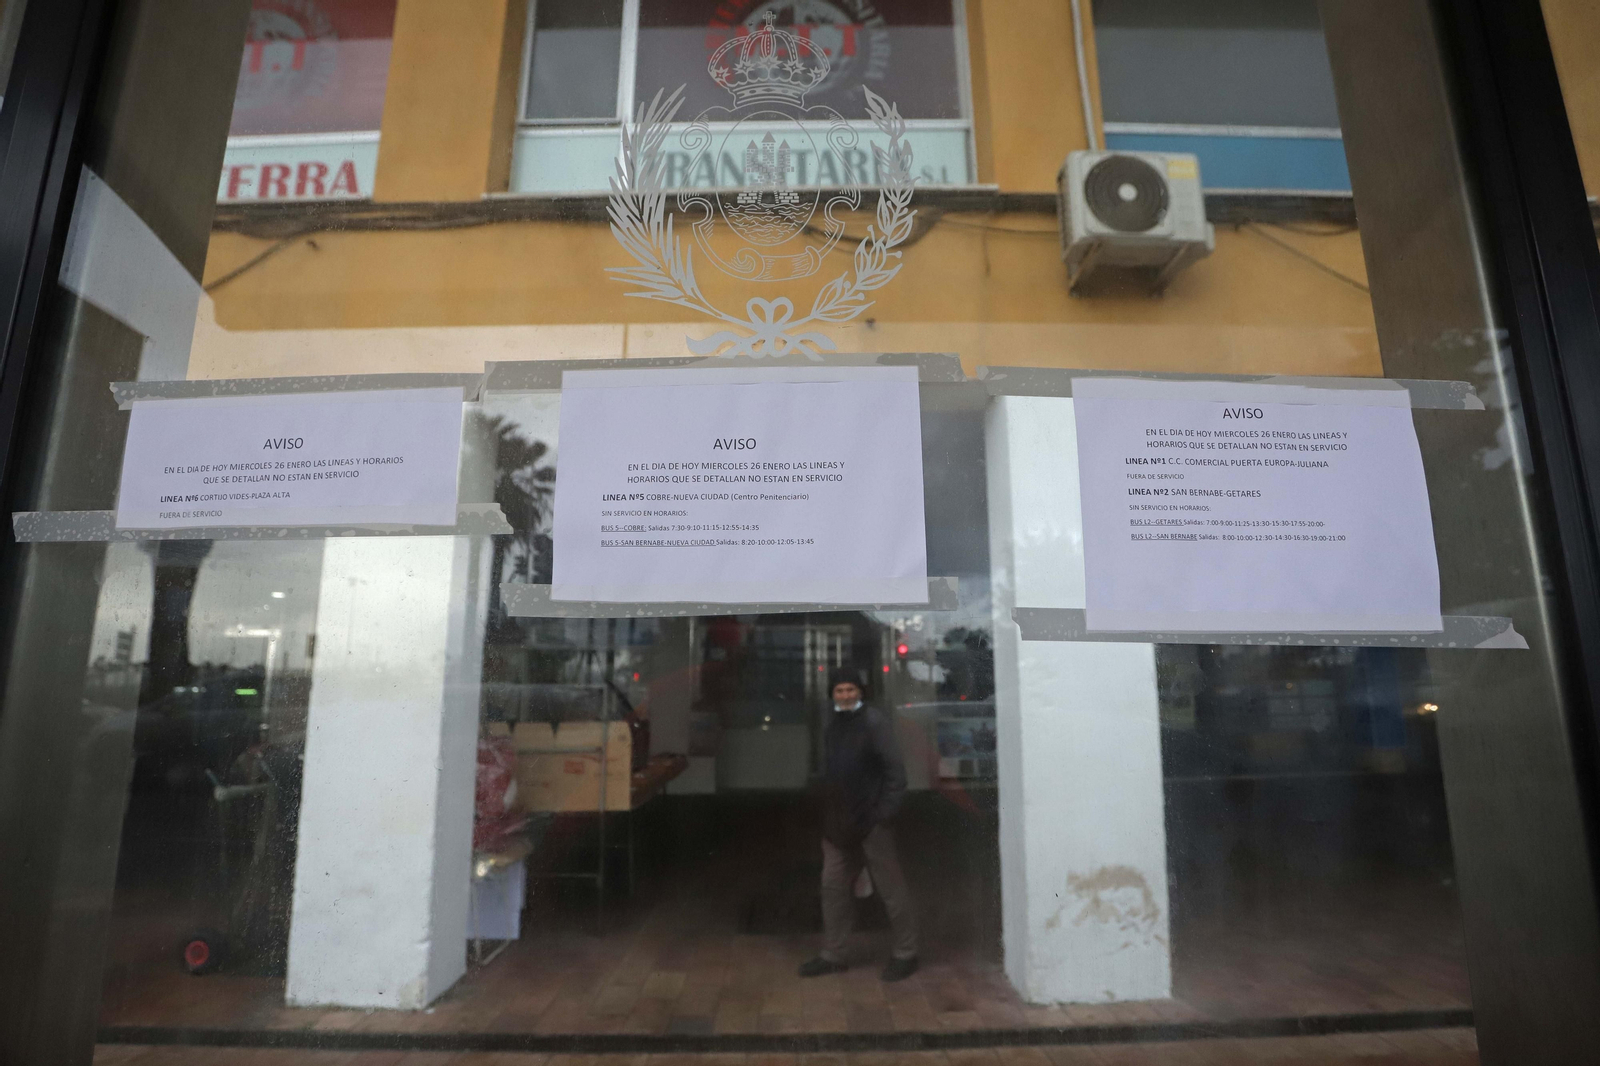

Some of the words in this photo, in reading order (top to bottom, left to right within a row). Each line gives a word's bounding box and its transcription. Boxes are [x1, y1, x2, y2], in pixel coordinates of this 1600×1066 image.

[1222, 408, 1264, 419] AVISO
[1159, 429, 1168, 437] EL
[1169, 429, 1183, 437] DIA
[1185, 429, 1195, 437] DE
[1214, 430, 1259, 438] MIERCOLES
[1261, 430, 1271, 438] 26
[1272, 430, 1297, 438] ENERO
[1312, 431, 1342, 439] LINEAS
[1342, 431, 1348, 439] Y
[263, 437, 304, 450] AVISO
[713, 438, 757, 450] AVISO
[1146, 441, 1188, 449] HORARIOS
[1189, 441, 1205, 449] QUE
[1206, 442, 1216, 450] SE
[1218, 442, 1259, 450] DETALLAN
[1260, 442, 1272, 450] NO
[1274, 442, 1297, 451] ESTAN
[1299, 443, 1309, 451] EN
[1310, 443, 1348, 451] SERVICIO
[164, 466, 175, 475] EN
[176, 466, 186, 474] EL
[187, 465, 200, 474] DIA
[200, 464, 211, 473] DE
[212, 463, 228, 472] HOY
[229, 461, 272, 471] MIERCOLES
[274, 461, 285, 470] 26
[286, 460, 312, 469] ENERO
[313, 459, 327, 468] LAS
[328, 458, 354, 467] LINEAS
[355, 457, 361, 466] Y
[362, 456, 404, 466] HORARIOS
[627, 463, 639, 471] EN
[640, 463, 650, 471] EL
[651, 463, 666, 471] DIA
[668, 463, 679, 471] DE
[701, 462, 749, 470] MIERCOLES
[750, 462, 761, 470] 26
[762, 462, 791, 470] ENERO
[809, 461, 838, 469] LINEAS
[839, 461, 845, 469] Y
[1125, 458, 1149, 466] LINEA
[1184, 458, 1229, 467] COMERCIAL
[1231, 459, 1262, 467] PUERTA
[1264, 460, 1329, 468] EUROPA-JULIANA
[203, 475, 219, 485] QUE
[220, 475, 230, 484] SE
[232, 474, 271, 484] DETALLAN
[272, 473, 285, 482] NO
[287, 472, 312, 482] ESTAN
[313, 472, 323, 480] EN
[324, 470, 359, 480] SERVICIO
[627, 475, 670, 483] HORARIOS
[671, 475, 690, 483] QUE
[691, 475, 701, 483] SE
[703, 475, 746, 483] DETALLAN
[748, 474, 762, 482] NO
[763, 474, 790, 482] ESTAN
[792, 474, 804, 482] EN
[805, 474, 843, 482] SERVICIO
[160, 495, 184, 503] LINEA
[200, 493, 227, 502] CORTIJO
[272, 491, 291, 499] ALTA
[602, 494, 627, 502] LINEA
[700, 493, 729, 501] CIUDAD
[730, 493, 758, 501] (Centro
[760, 493, 810, 501] Penitenciario)
[1128, 488, 1152, 496] LINEA
[1189, 489, 1261, 498] BERNABE-GETARES
[159, 511, 181, 519] FUERA
[181, 510, 192, 519] DE
[192, 509, 223, 518] SERVICIO
[600, 539, 614, 547] BUS
[635, 539, 691, 547] BERNABE-NUEVA
[691, 539, 715, 547] CIUDAD
